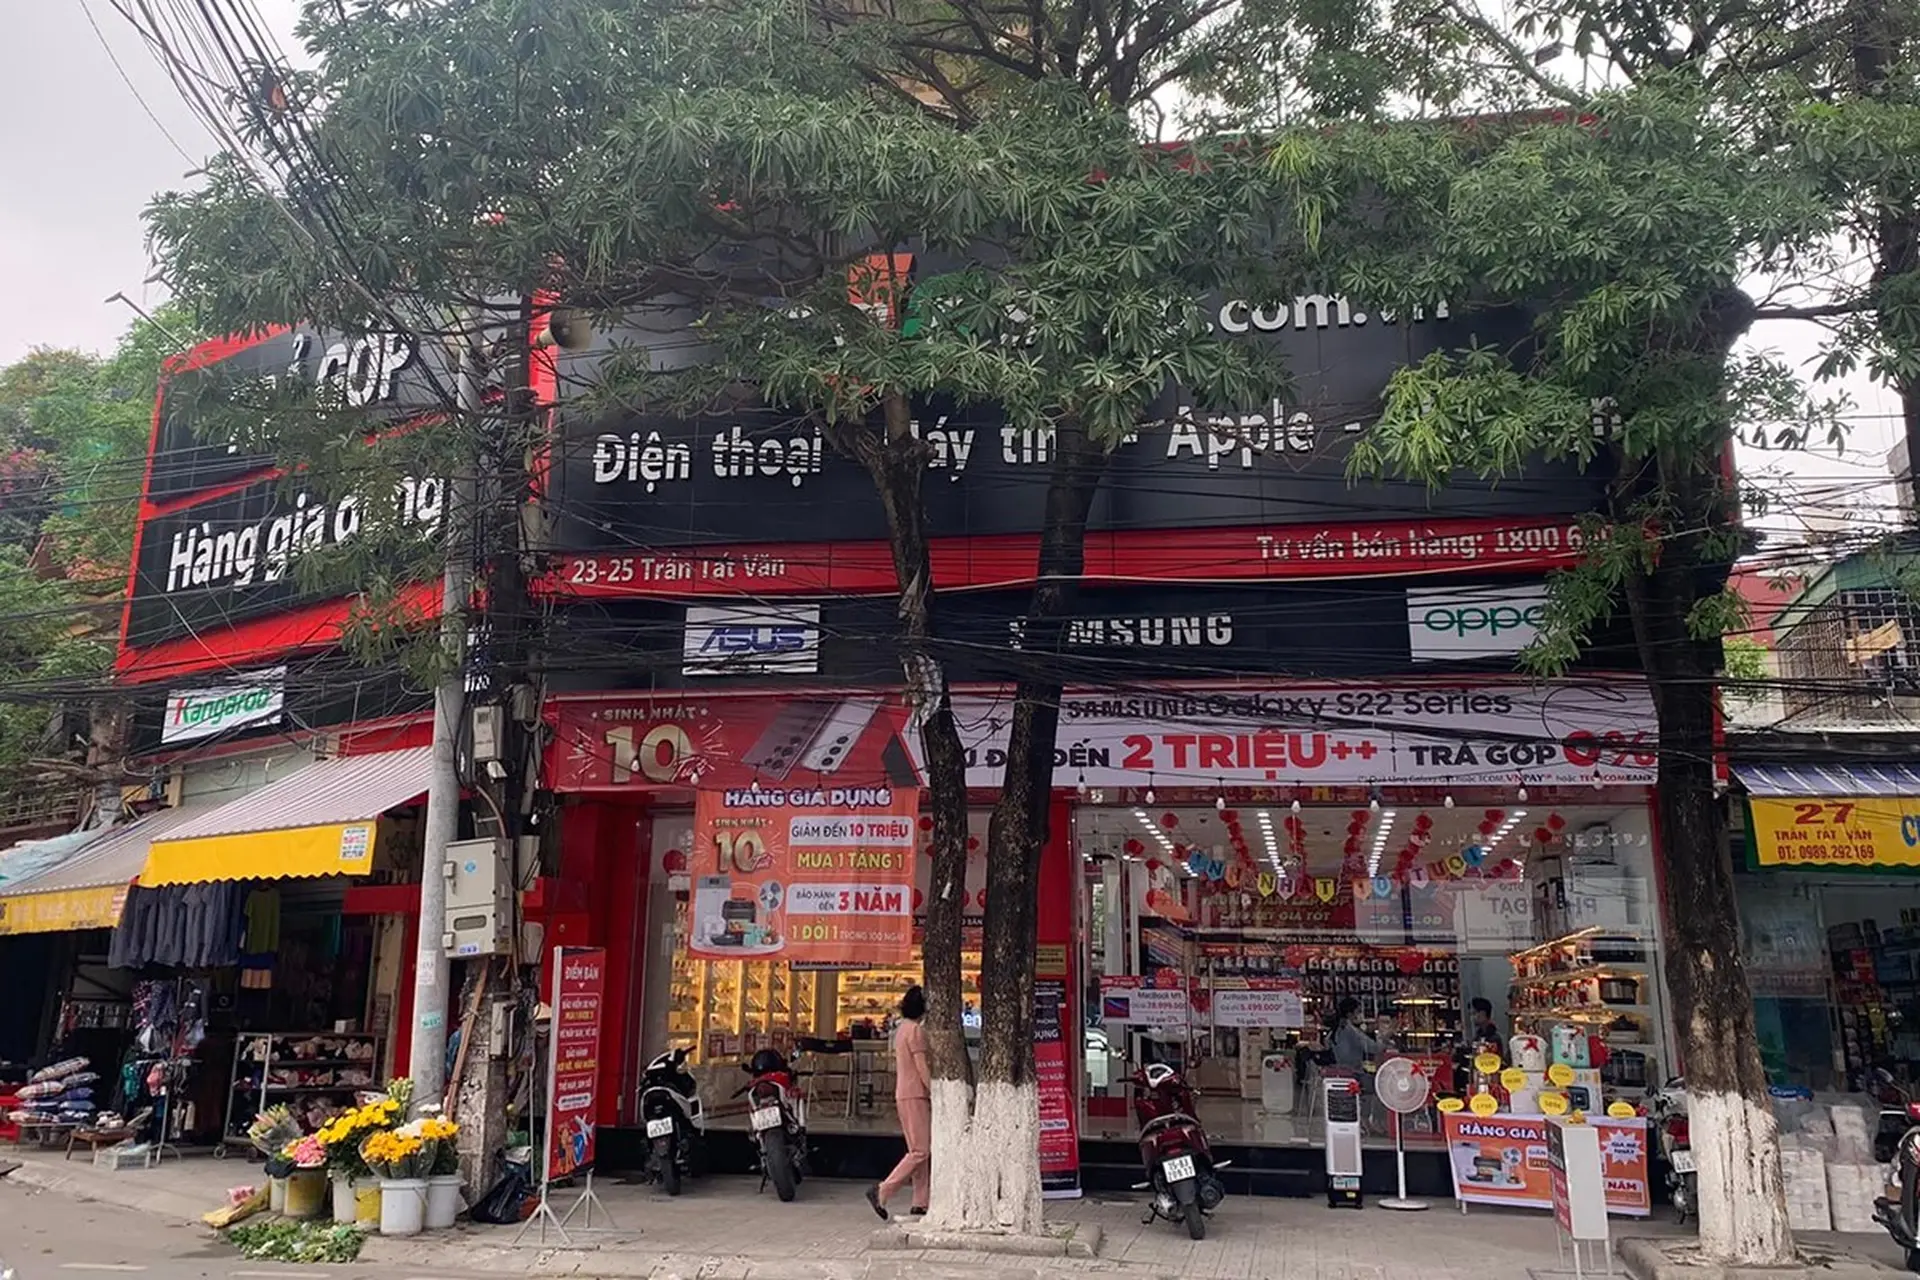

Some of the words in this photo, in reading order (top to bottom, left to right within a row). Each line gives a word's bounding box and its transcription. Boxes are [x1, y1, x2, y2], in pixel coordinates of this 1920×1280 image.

[592, 429, 692, 493] Điện
[711, 425, 823, 488] thoại
[884, 415, 976, 482] áy
[1165, 397, 1317, 471] Apple
[166, 521, 260, 593] Hàng
[263, 492, 326, 582] gia
[1298, 530, 1345, 560] vấn
[1351, 530, 1401, 558] bán
[1408, 529, 1485, 560] hàng:
[1492, 525, 1560, 554] 1800
[570, 558, 634, 583] 23-25
[700, 627, 806, 652] ASUS
[174, 687, 271, 726] Kangaroo
[603, 707, 646, 722] SINH
[649, 704, 698, 722] NHẬT
[1066, 697, 1199, 719] SAMSUNG
[1336, 692, 1394, 716] S22
[1403, 690, 1513, 715] Series
[605, 723, 693, 786] 10
[1053, 737, 1110, 768] ĐẾN
[1122, 733, 1155, 769] 2
[1486, 740, 1557, 767] GÓP
[1562, 730, 1658, 768] 0%
[1579, 773, 1654, 784] TECCOMBANK
[724, 788, 785, 807] HÀNG
[789, 790, 826, 807] GIA
[830, 788, 892, 810] DỤNG
[1794, 802, 1855, 825] 27
[791, 822, 822, 838] GIẢM
[823, 821, 848, 839] ĐẾN
[849, 822, 864, 838] 10
[866, 819, 909, 842] TRIỆU
[714, 830, 764, 874] 10
[797, 852, 834, 869] MUA
[837, 852, 845, 868] 1
[849, 850, 893, 871] TẶNG
[896, 852, 904, 868] 1
[838, 892, 851, 912] 3
[853, 887, 902, 912] NĂM
[791, 925, 798, 940] 1
[801, 916, 830, 941] ĐỔI
[832, 925, 839, 940] 1
[1458, 1120, 1506, 1138] HÀNG
[1508, 1126, 1538, 1141] GIA
